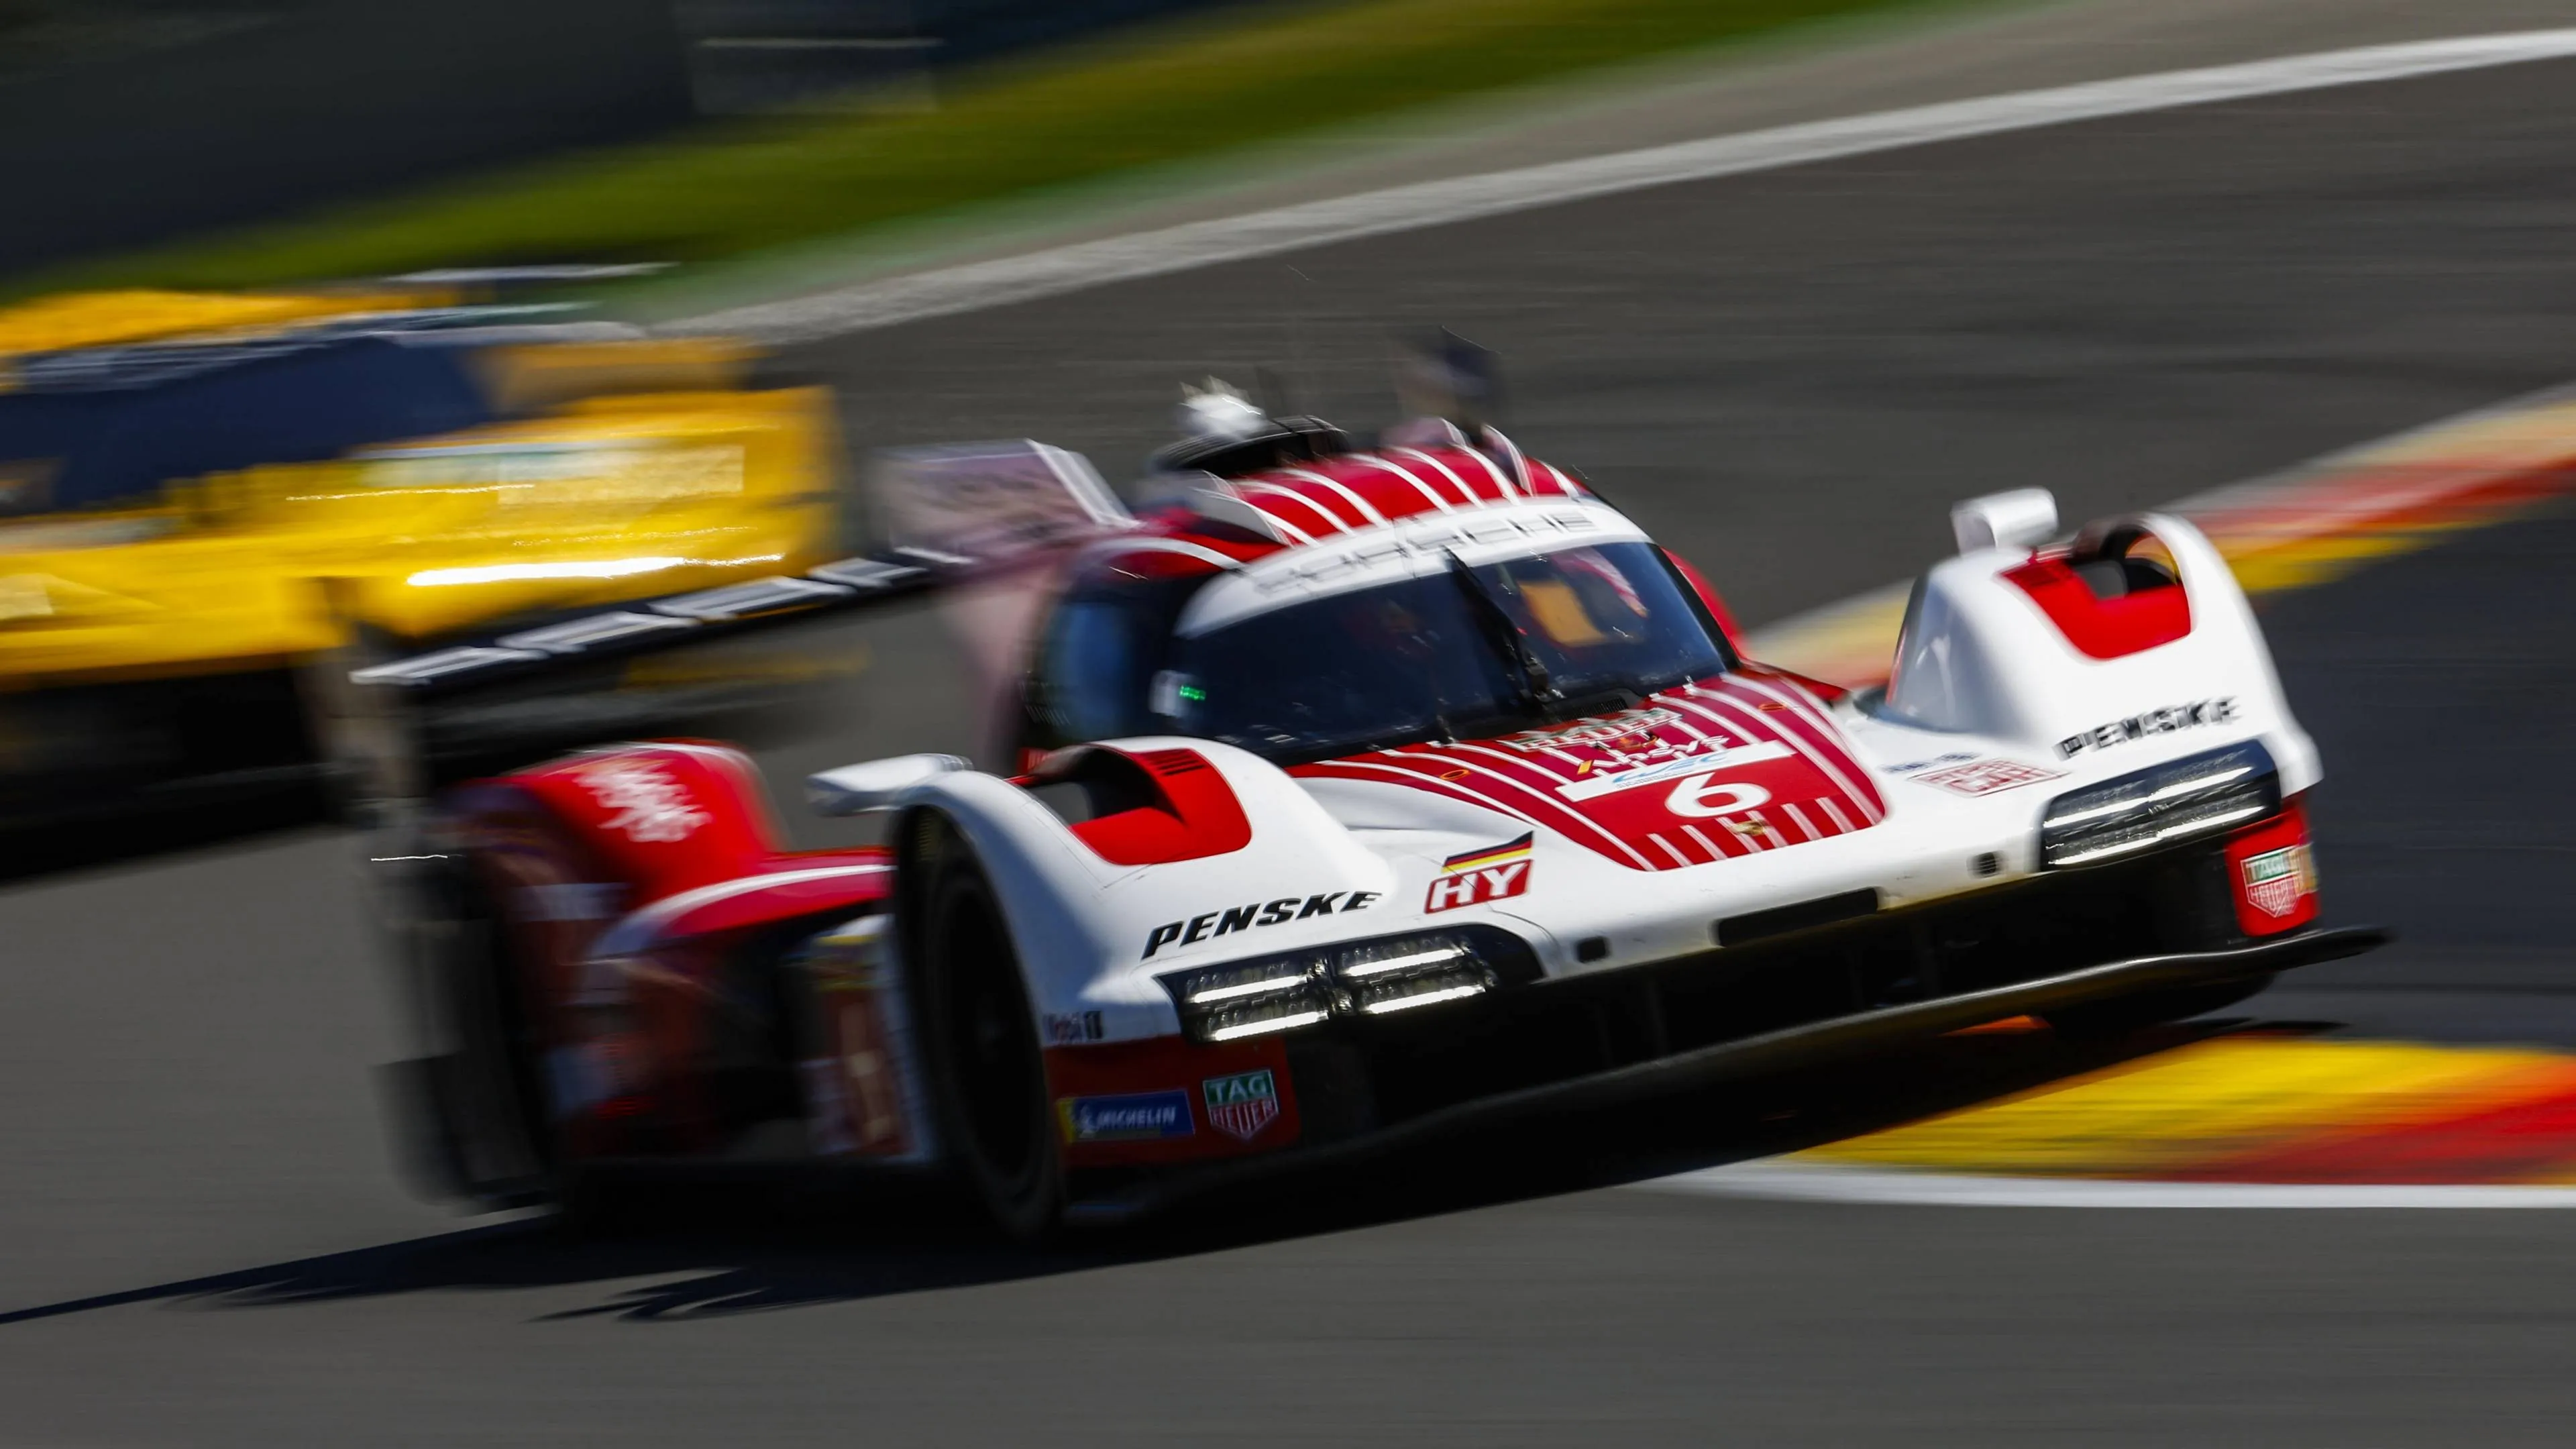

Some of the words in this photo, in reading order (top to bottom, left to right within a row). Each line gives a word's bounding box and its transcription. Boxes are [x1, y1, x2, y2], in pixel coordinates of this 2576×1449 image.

[2051, 696, 2243, 761] PENSKE
[1577, 735, 1729, 775] Ansys
[1665, 772, 1772, 817] 6
[1430, 862, 1527, 909] HY
[1141, 891, 1383, 960] PENSKE
[1208, 1075, 1267, 1104] TAG
[1096, 1106, 1177, 1131] MICHELIN
[1210, 1099, 1275, 1136] HEUER
